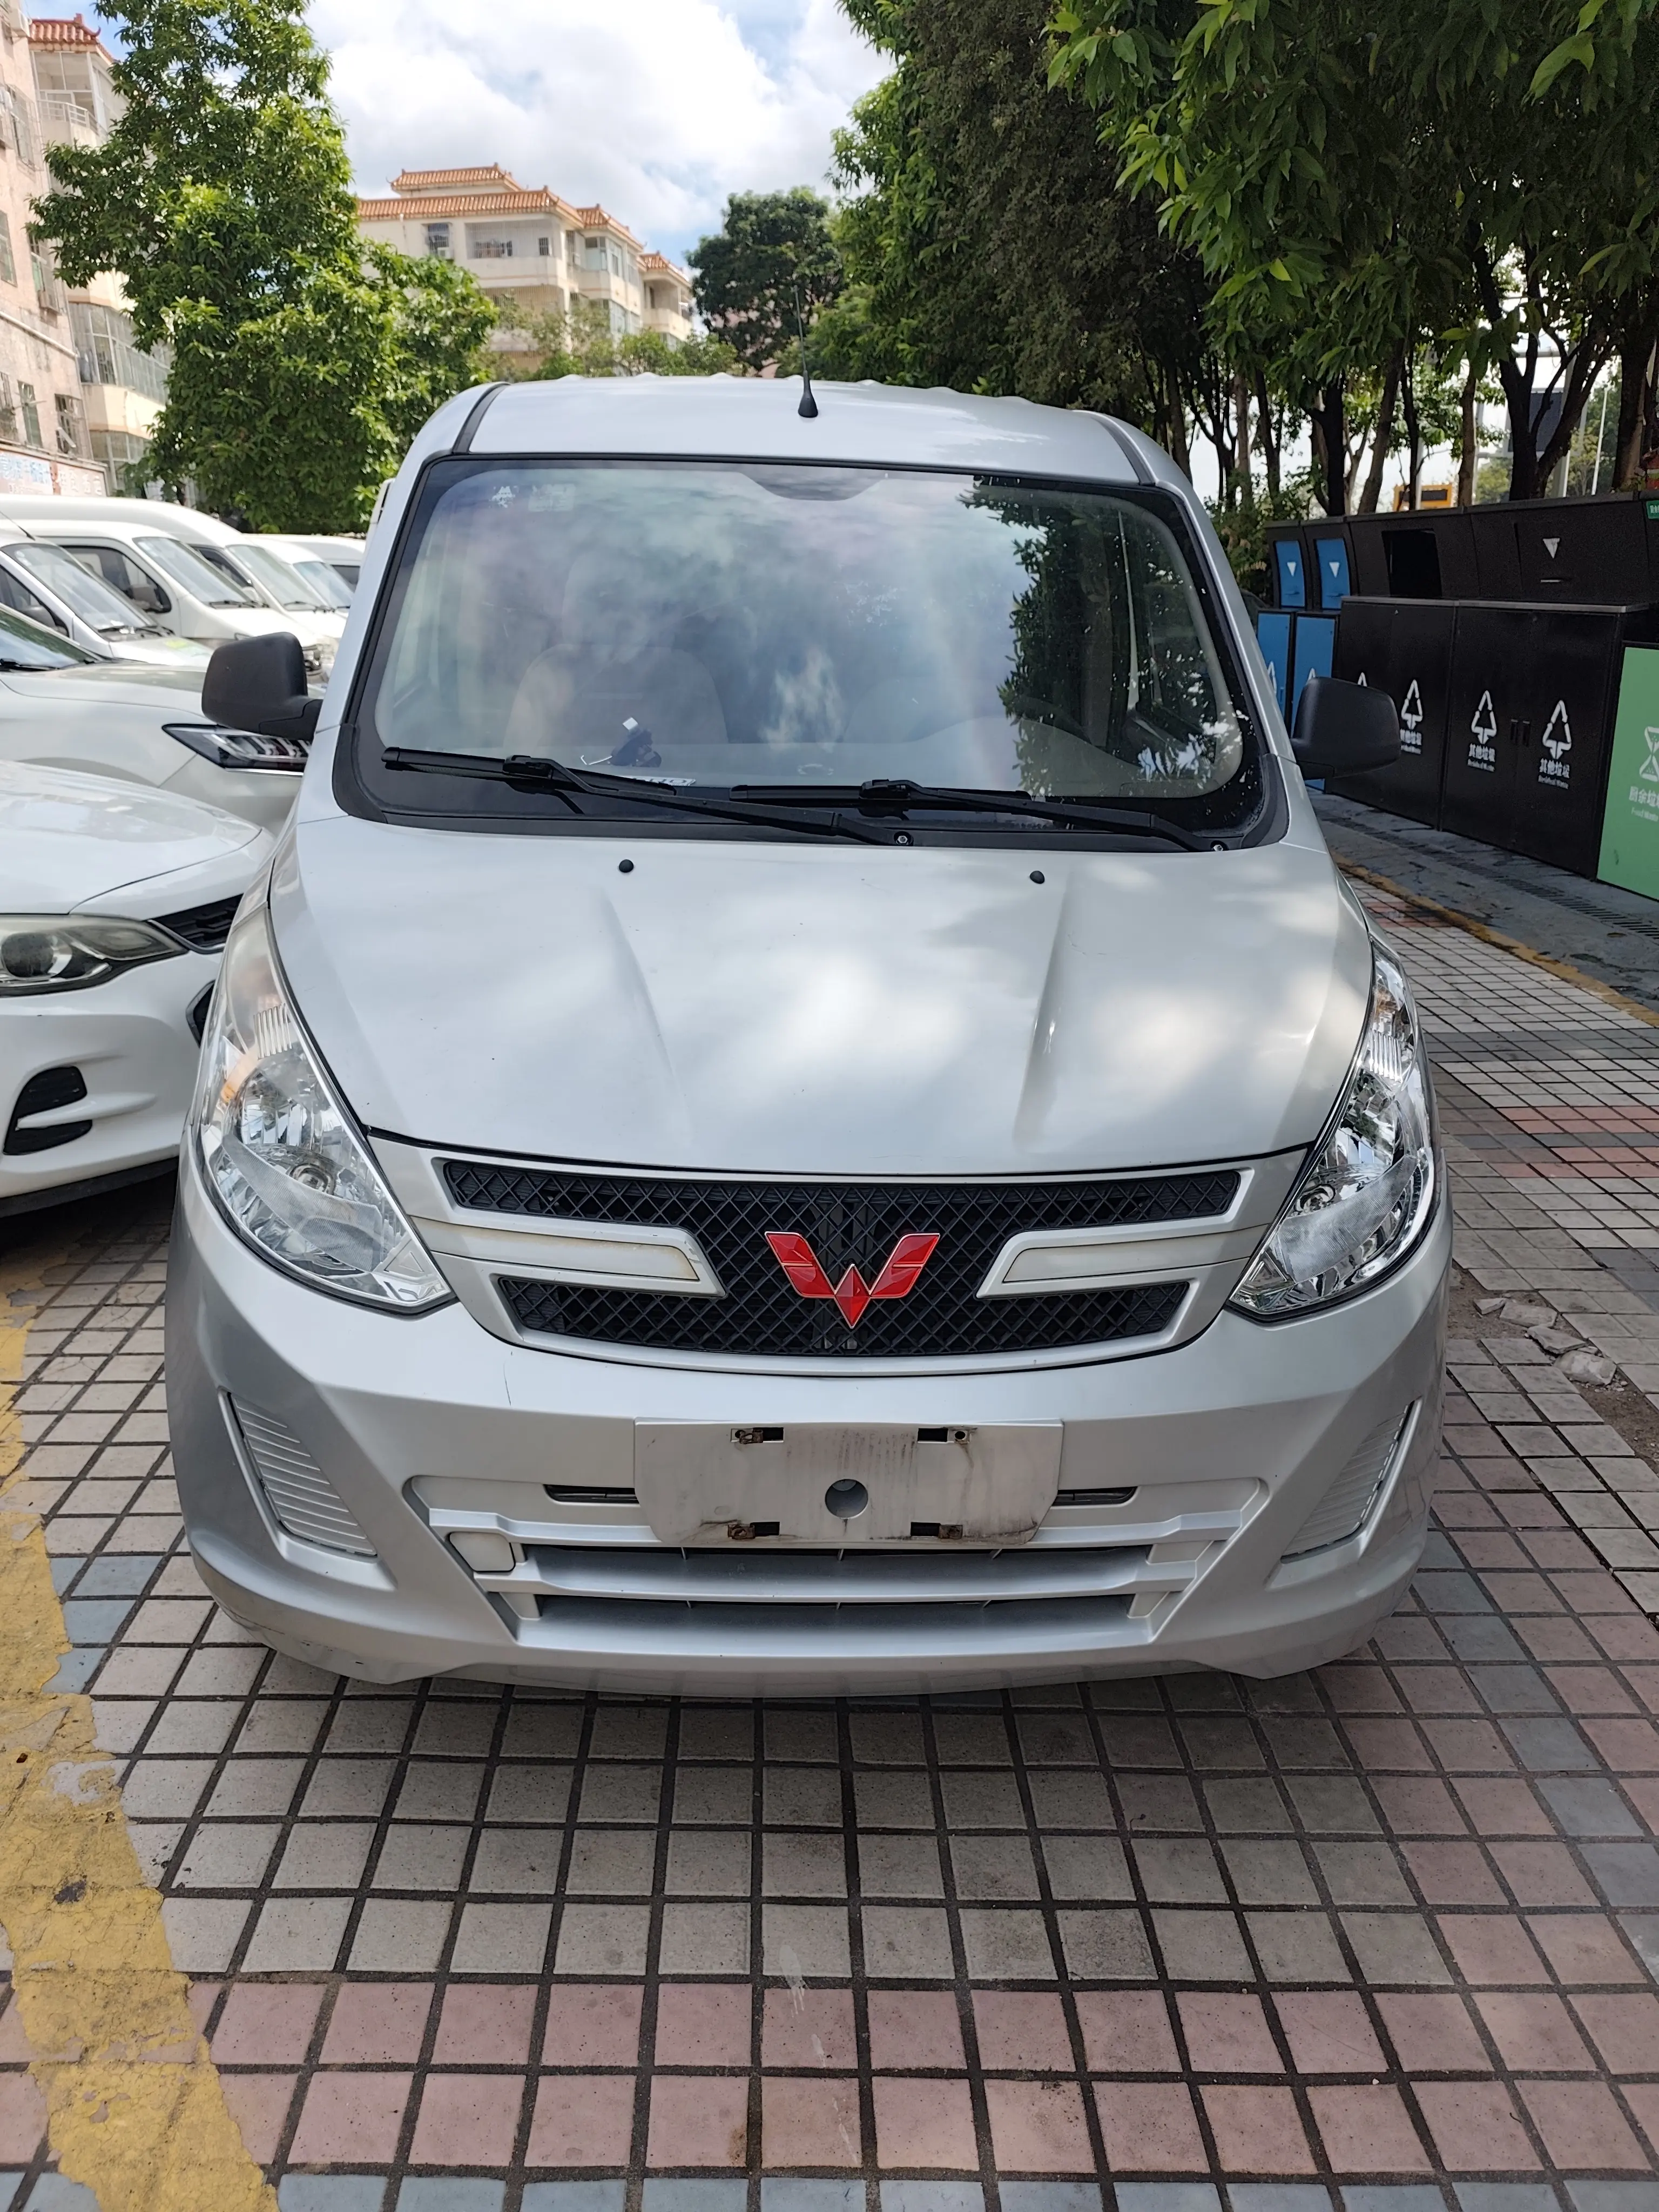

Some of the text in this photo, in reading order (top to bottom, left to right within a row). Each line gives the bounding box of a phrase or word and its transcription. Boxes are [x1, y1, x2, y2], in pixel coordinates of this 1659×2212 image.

[1469, 743, 1495, 762] 其他垃圾
[1539, 758, 1570, 779] 其他垃圾
